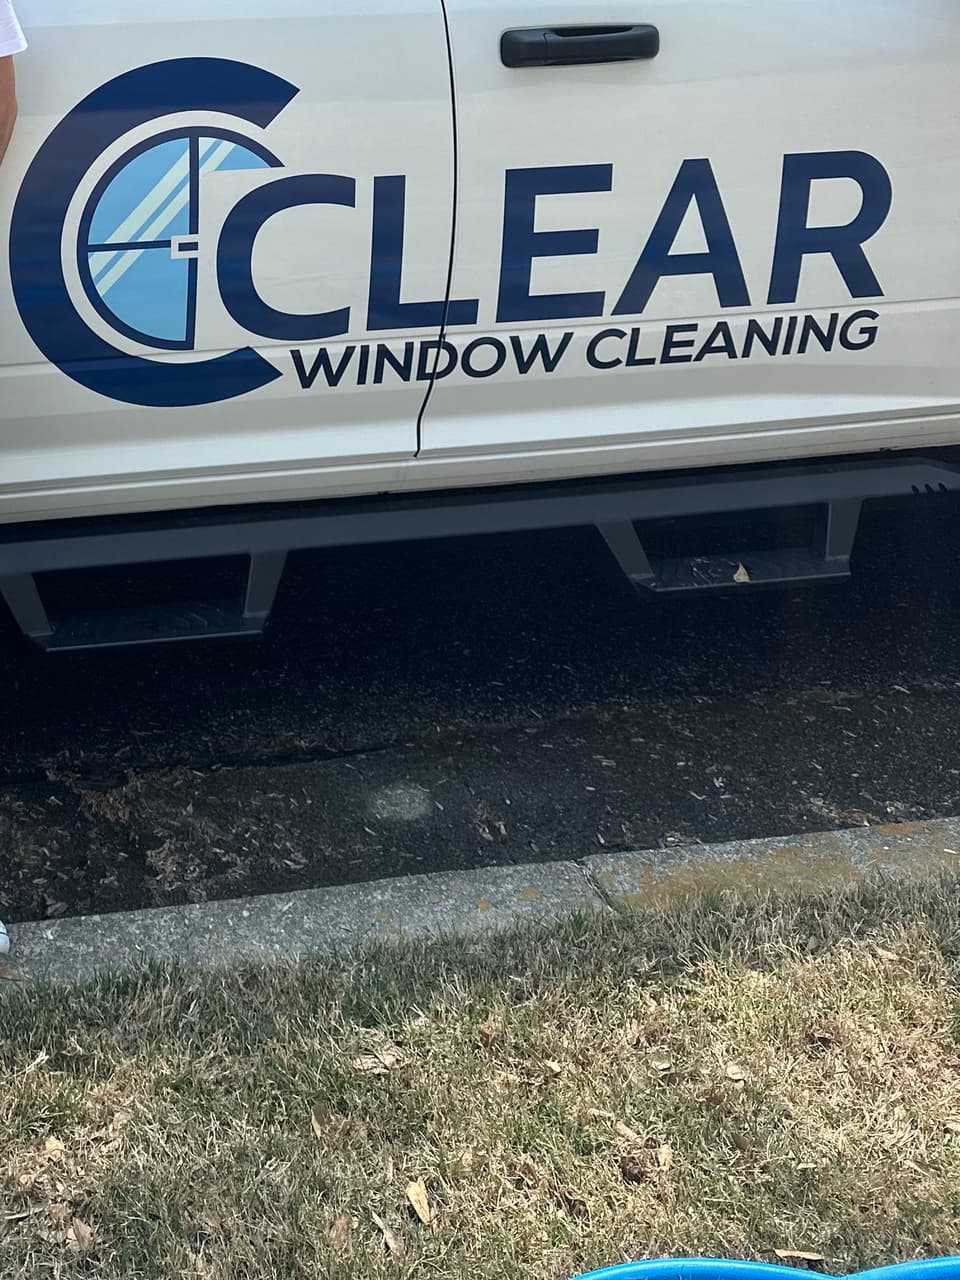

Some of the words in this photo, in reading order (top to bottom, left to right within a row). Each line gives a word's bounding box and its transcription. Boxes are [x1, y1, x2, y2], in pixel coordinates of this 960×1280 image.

[216, 150, 893, 341] CLEAR
[290, 332, 575, 389] WINDOW
[585, 309, 880, 370] CLEANING
